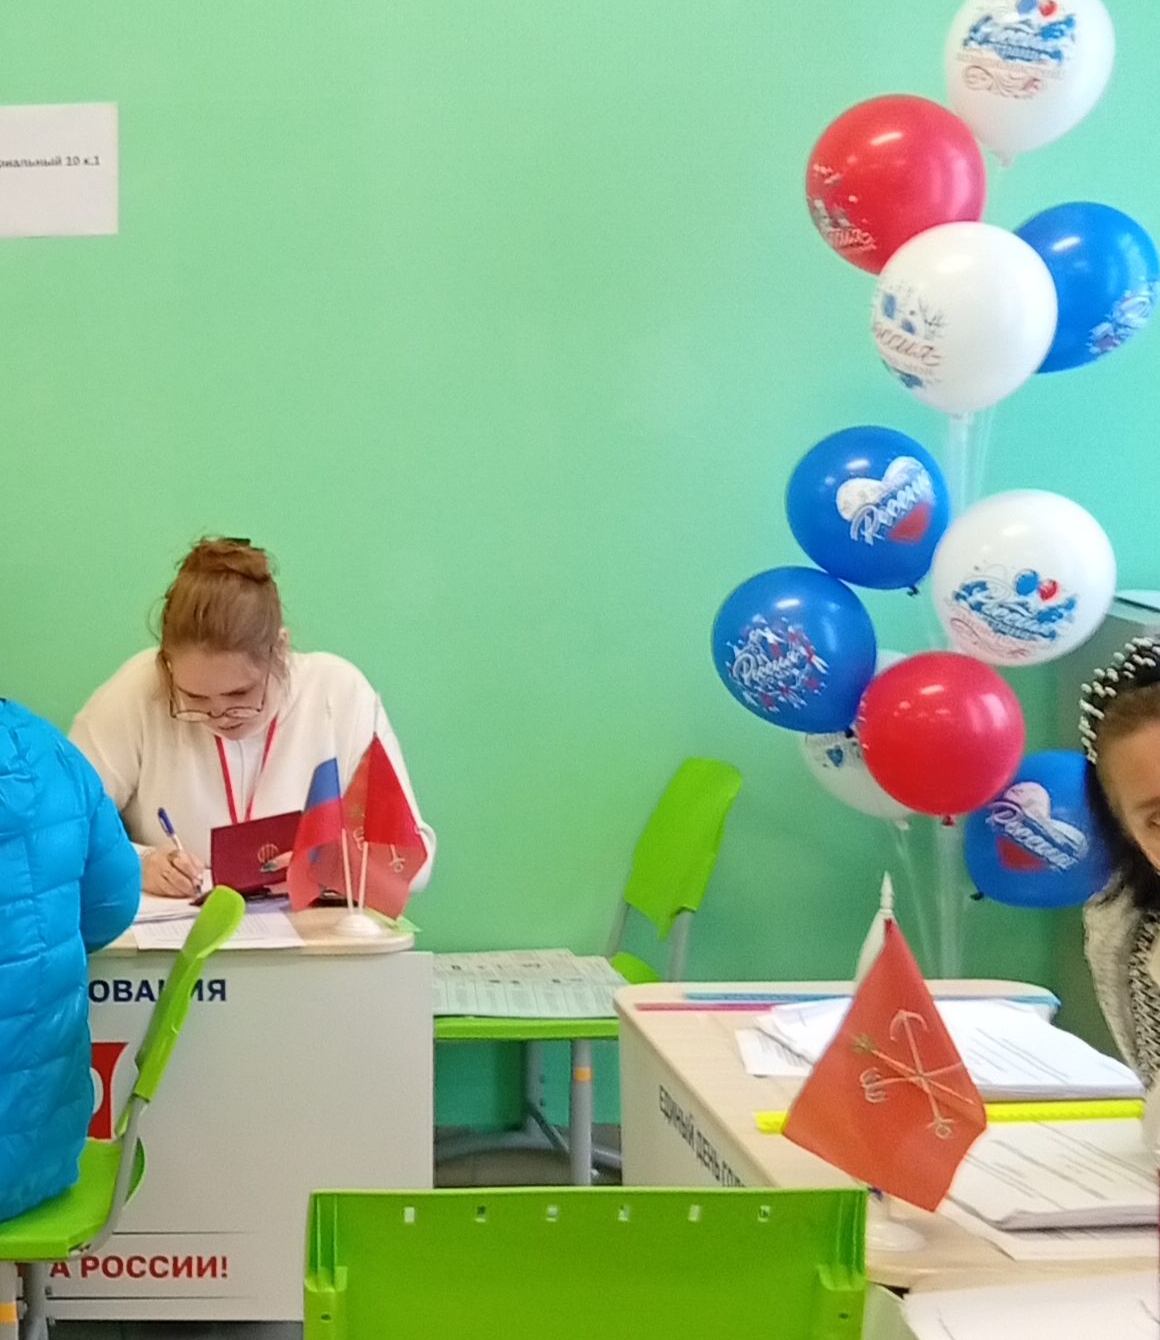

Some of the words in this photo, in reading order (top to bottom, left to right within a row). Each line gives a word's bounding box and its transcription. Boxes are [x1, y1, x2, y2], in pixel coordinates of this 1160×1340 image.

[66, 156, 80, 167] 10
[659, 1084, 695, 1152] ЕДИНЫЙ
[696, 1130, 721, 1182] ДЕНЬ
[81, 1255, 228, 1279] РОССИИ!
